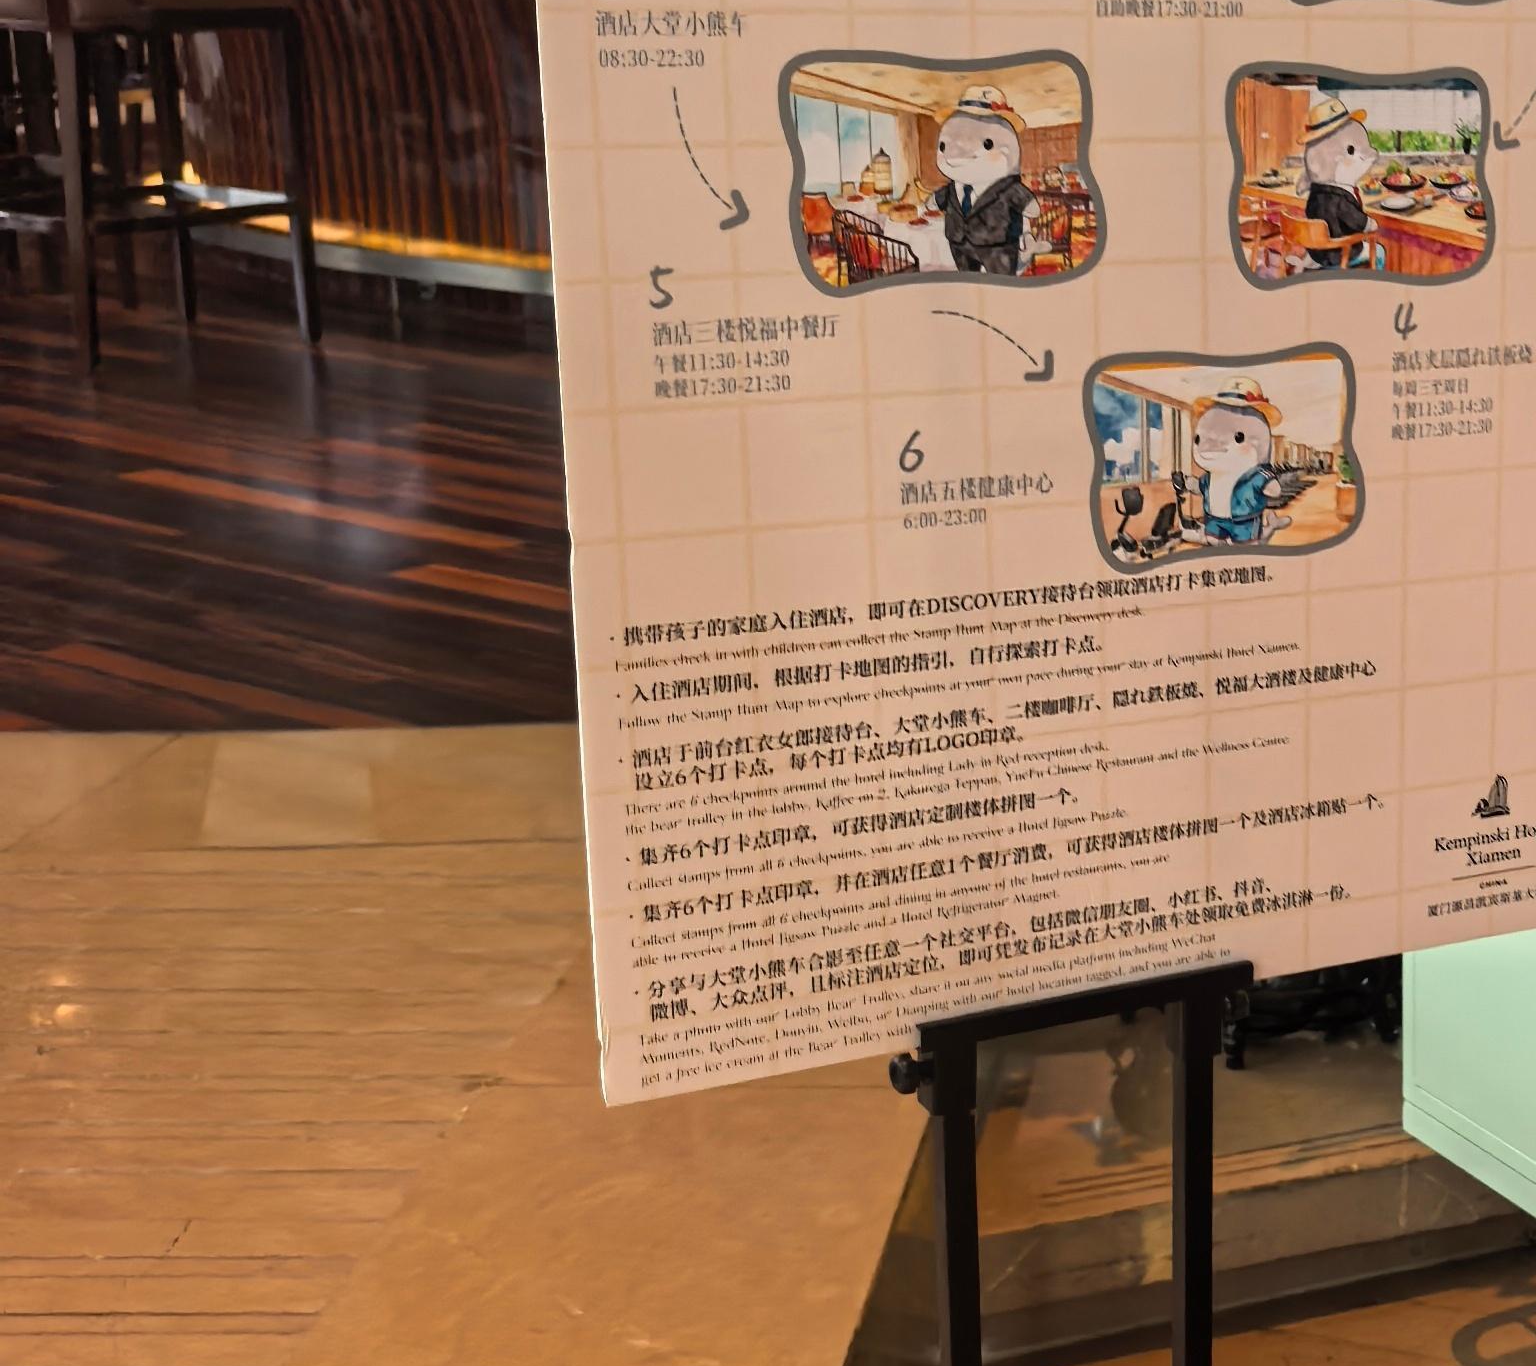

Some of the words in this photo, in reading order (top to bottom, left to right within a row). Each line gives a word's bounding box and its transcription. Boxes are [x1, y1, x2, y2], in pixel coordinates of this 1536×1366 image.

[595, 9, 747, 38] 酒店大堂小熊车
[598, 48, 706, 68] 08:30-22:30
[649, 264, 675, 310] 5
[652, 314, 841, 347] 酒店三楼悦福中餐厅
[1394, 301, 1418, 341] 4
[654, 348, 791, 375] 午餐11:30-14:30
[654, 374, 792, 399] 晚餐17:30-21:30
[898, 428, 925, 473] 6
[900, 470, 1055, 506] 酒店五楼健康中心
[902, 507, 988, 530] 6:00-23:00
[1434, 827, 1511, 853] Kempinski
[1465, 847, 1522, 867] Xiamen
